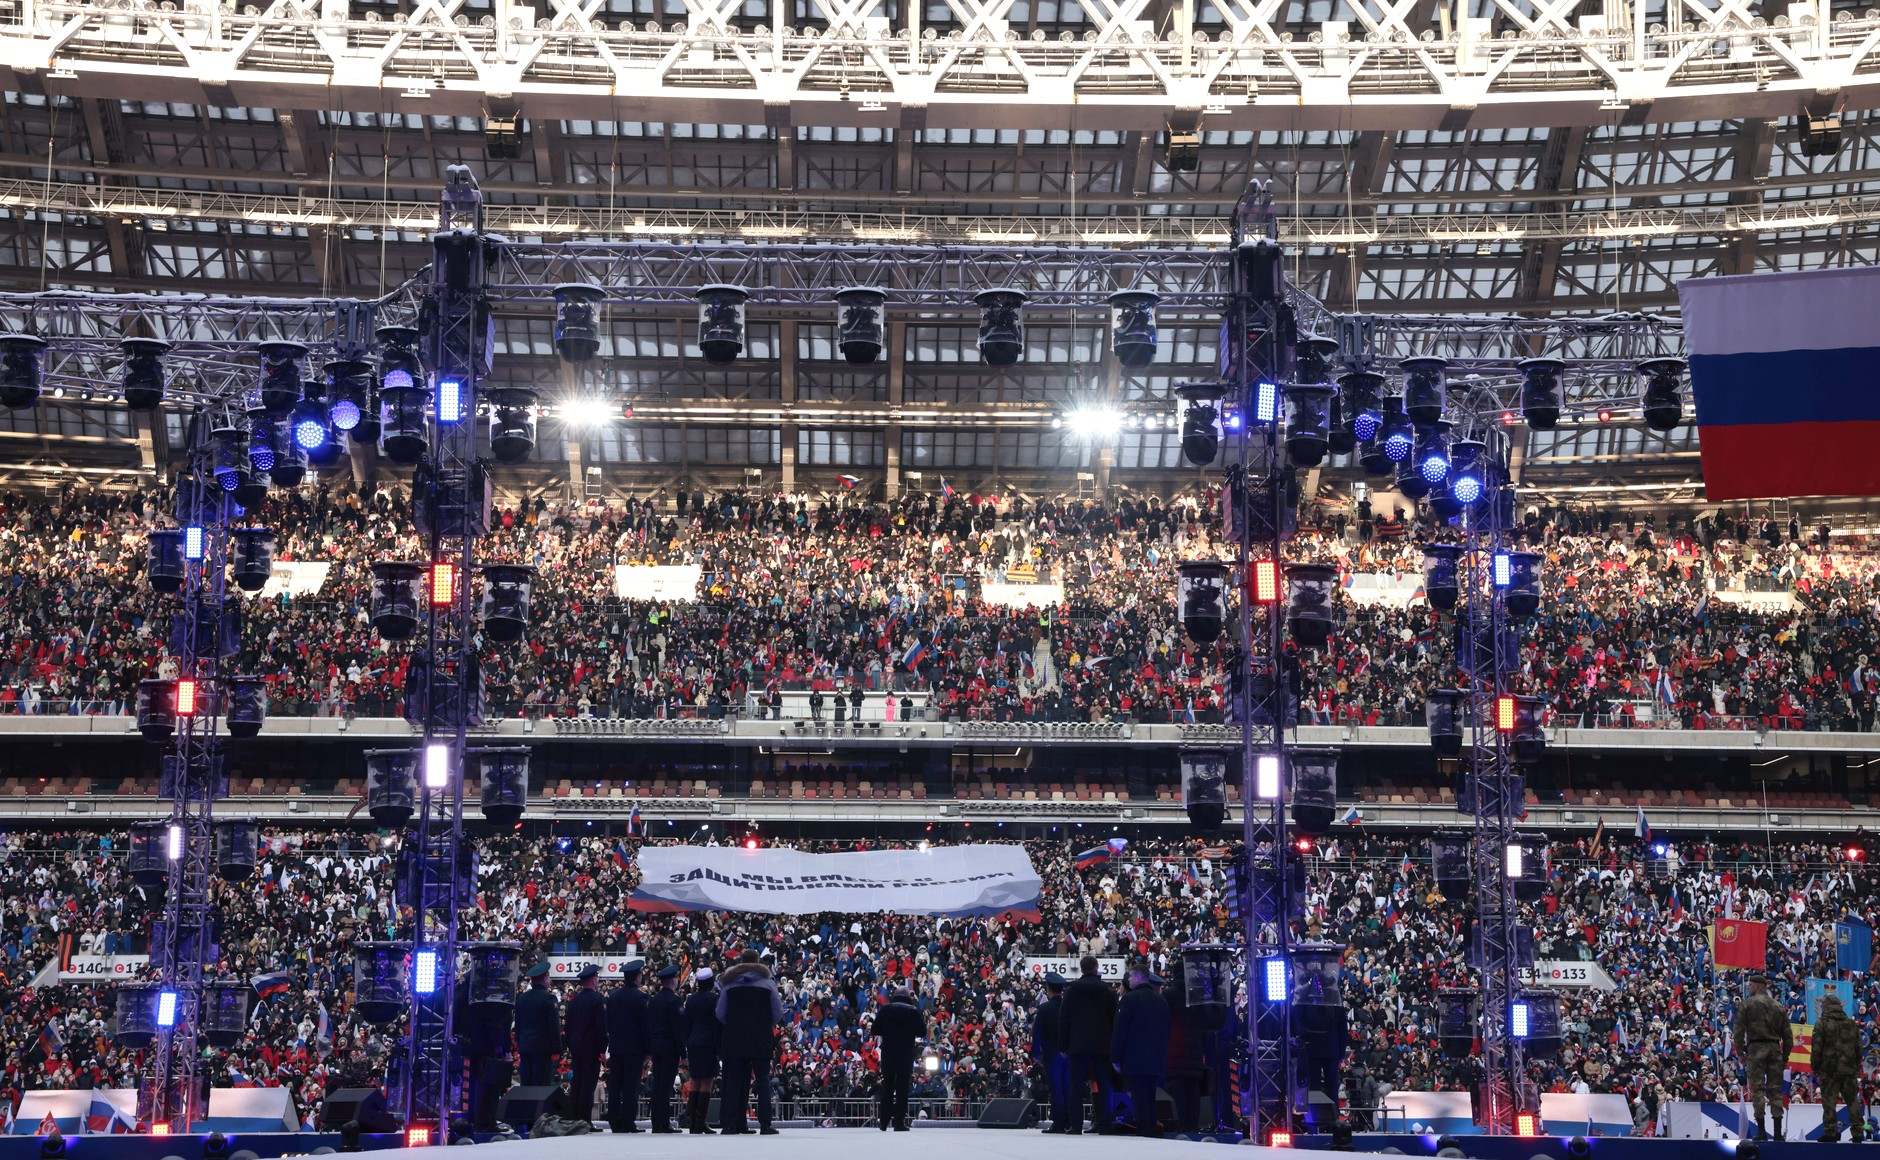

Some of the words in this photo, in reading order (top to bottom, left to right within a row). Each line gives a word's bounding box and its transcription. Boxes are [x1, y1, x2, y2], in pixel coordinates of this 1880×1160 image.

[1762, 601, 1783, 610] 237
[669, 867, 884, 891] ЗАЩИТНИКАМИ
[741, 873, 793, 884] МЫ
[78, 963, 103, 974] 140
[126, 963, 143, 973] 13
[1043, 963, 1067, 974] 136
[1102, 963, 1118, 975] 35
[1518, 968, 1541, 979] 134
[1562, 968, 1586, 979] 133
